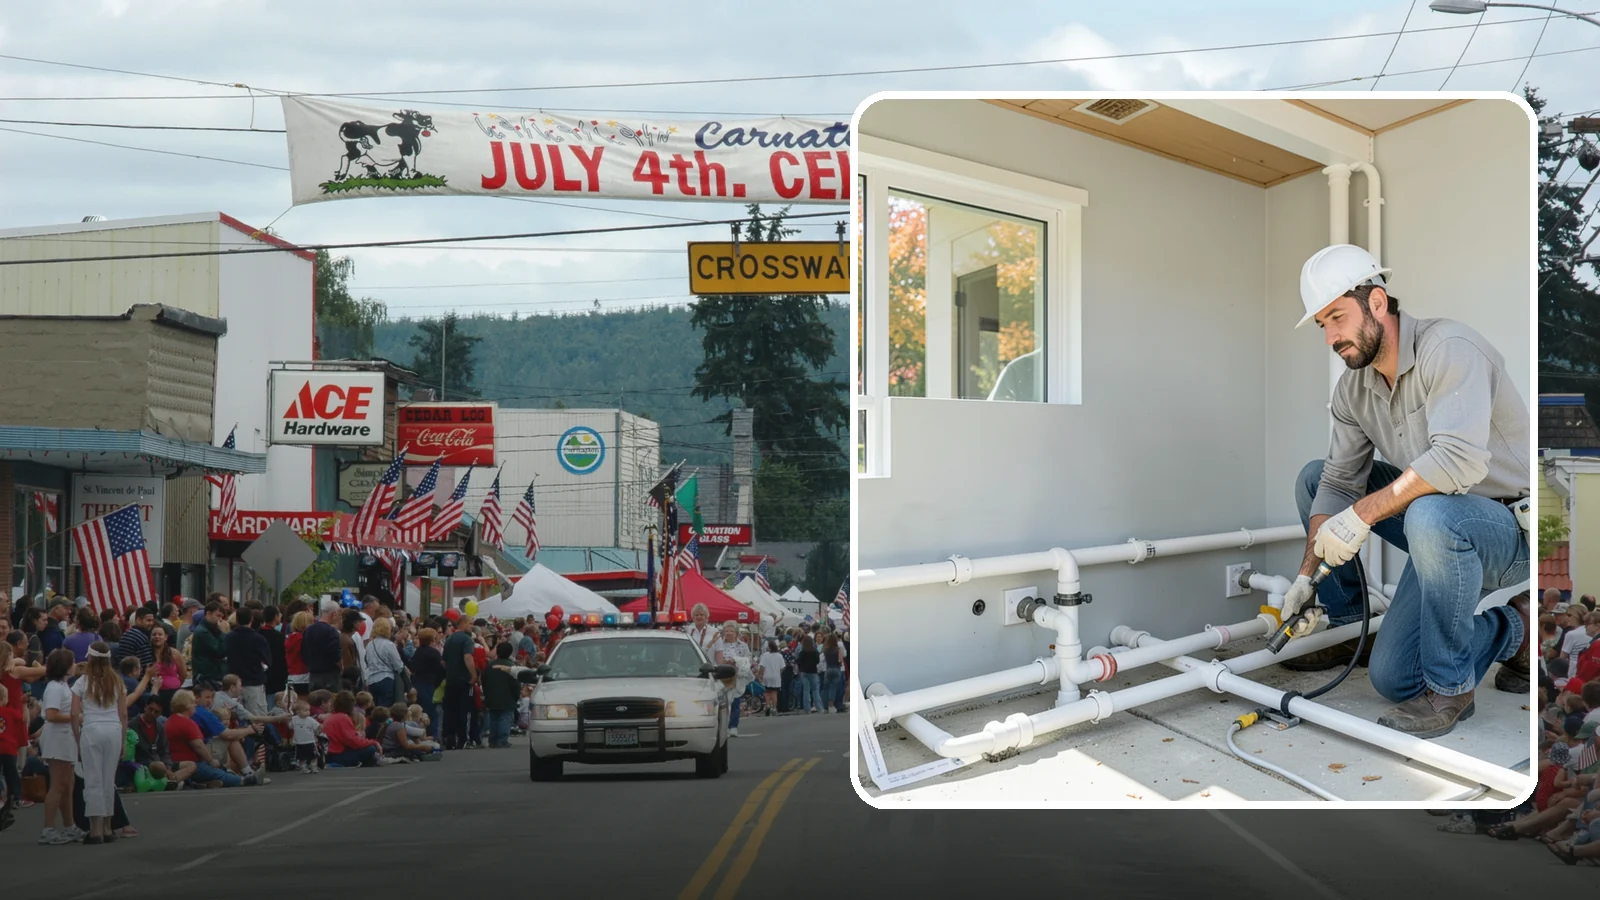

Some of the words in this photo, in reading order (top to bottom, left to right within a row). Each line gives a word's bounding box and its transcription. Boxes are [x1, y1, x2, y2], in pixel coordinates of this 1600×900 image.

[695, 121, 850, 150] Carnat
[481, 141, 605, 193] JULY
[632, 150, 746, 198] 4th.
[697, 254, 850, 280] CROSSWA
[282, 380, 373, 420] ACE
[405, 409, 453, 422] CEDAR
[461, 409, 485, 422] LOG
[283, 421, 371, 436] Hardware
[416, 428, 477, 447] Coca-Cola
[353, 467, 384, 480] Simpl
[96, 485, 124, 495] Vincent
[126, 485, 135, 495] de
[137, 485, 155, 496] Paul
[688, 526, 741, 535] CRNATION
[699, 535, 730, 544] GLASS
